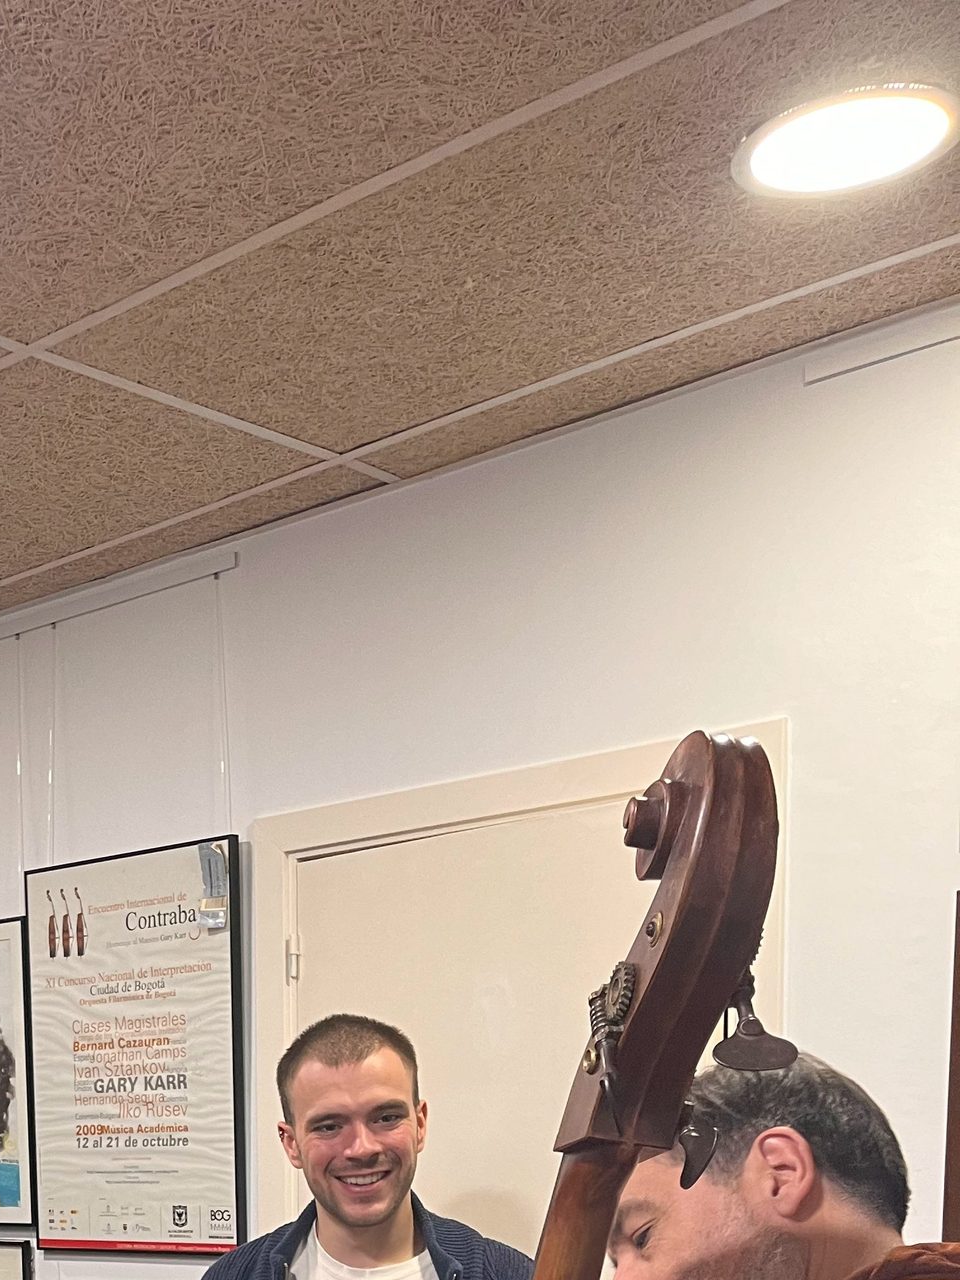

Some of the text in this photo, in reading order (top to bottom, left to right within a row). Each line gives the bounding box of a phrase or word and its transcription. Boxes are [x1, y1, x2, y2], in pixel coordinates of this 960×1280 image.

[127, 894, 175, 910] Internacional
[177, 891, 188, 902] de
[125, 904, 197, 931] Contraba
[58, 974, 96, 987] Concurso
[98, 970, 135, 983] Nacional
[137, 968, 148, 979] de
[150, 960, 212, 979] Interpretación
[90, 977, 166, 997] Ciudad de Bogotá
[72, 1019, 112, 1035] Clases
[114, 1011, 186, 1032] Magistrales
[73, 1038, 115, 1052] Bernard
[118, 1036, 170, 1050] Cazauran
[90, 1048, 142, 1064] Jonathan
[146, 1046, 187, 1062] Camps
[74, 1064, 100, 1079] Ivan
[104, 1060, 166, 1078] Sztankov
[94, 1074, 188, 1094] GARY KARR
[74, 1094, 124, 1106] Hernando
[127, 1092, 164, 1106] Segura
[146, 1102, 188, 1118] Rusev
[76, 1124, 102, 1136] 2009
[136, 1122, 189, 1134] Académica
[76, 1134, 189, 1149] 12 al 21 de octubre
